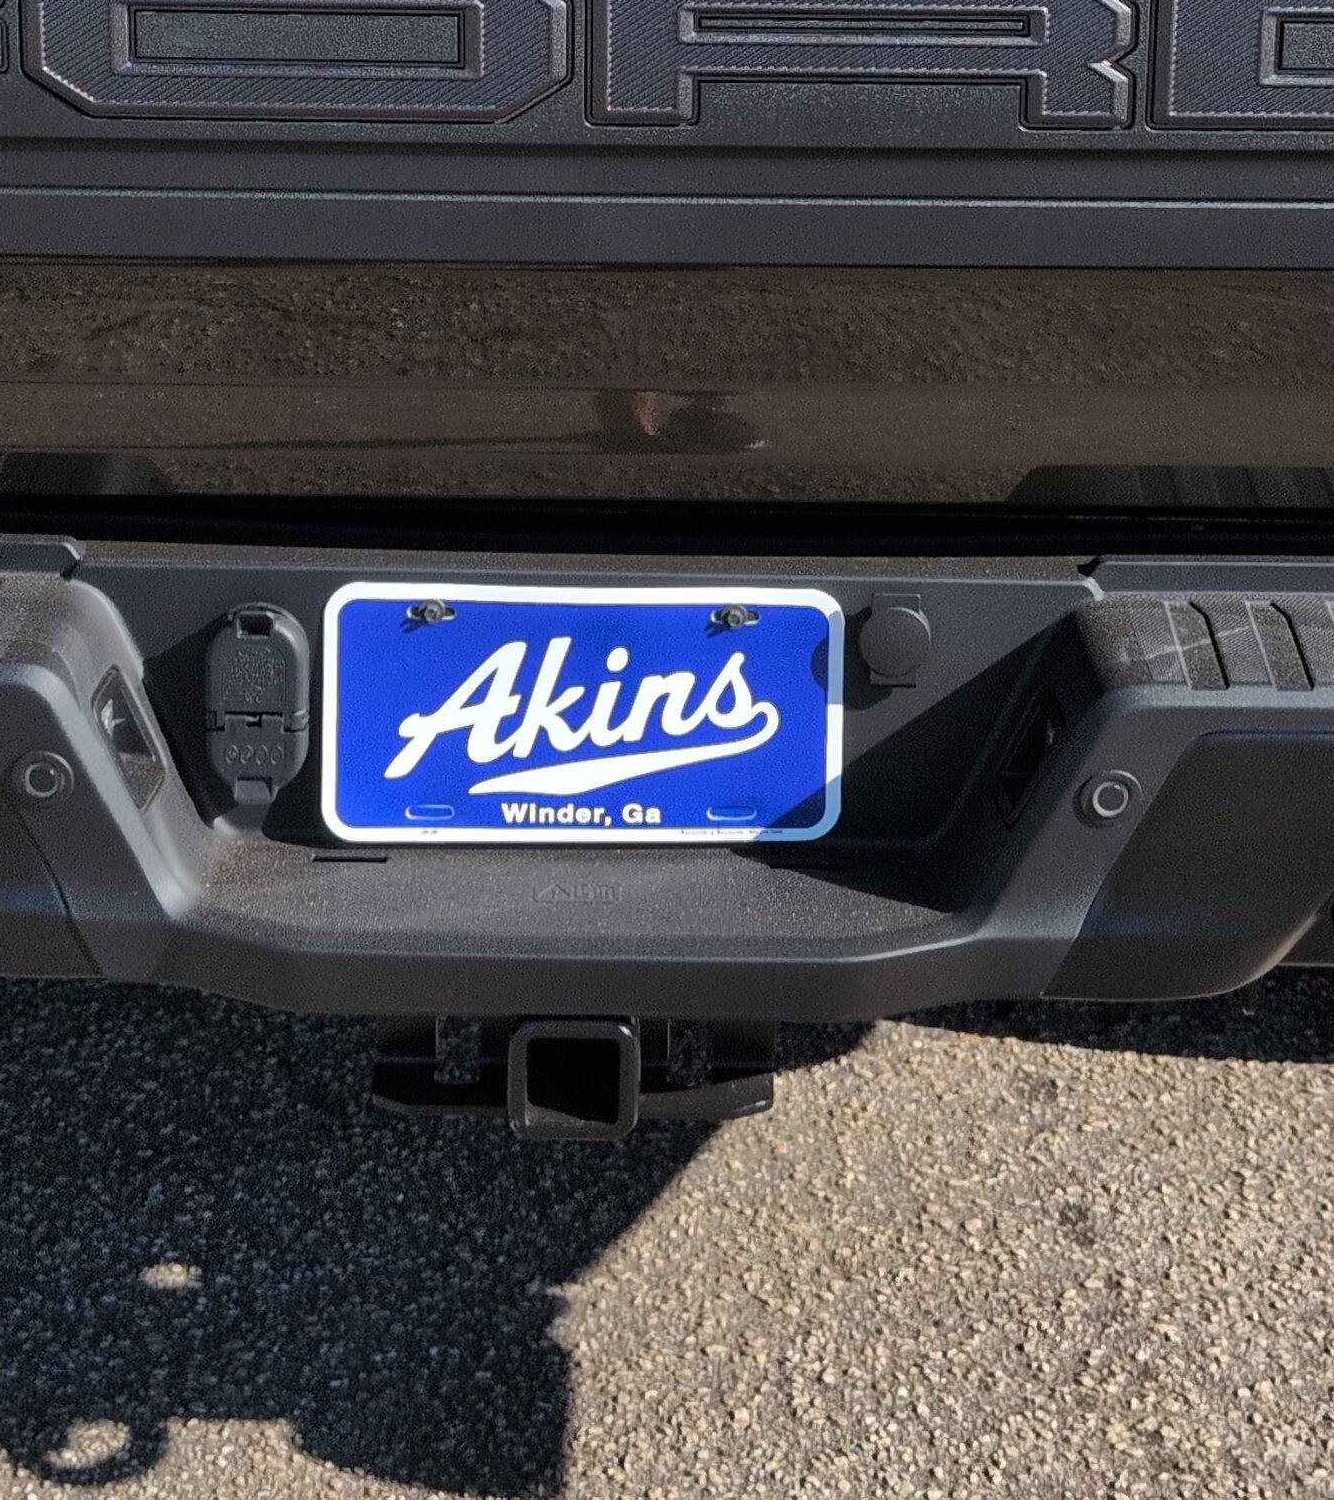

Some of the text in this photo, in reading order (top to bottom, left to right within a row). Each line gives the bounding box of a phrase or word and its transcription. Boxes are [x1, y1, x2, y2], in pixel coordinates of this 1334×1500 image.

[384, 636, 781, 795] Akins
[501, 803, 662, 827] Winder, Ga
